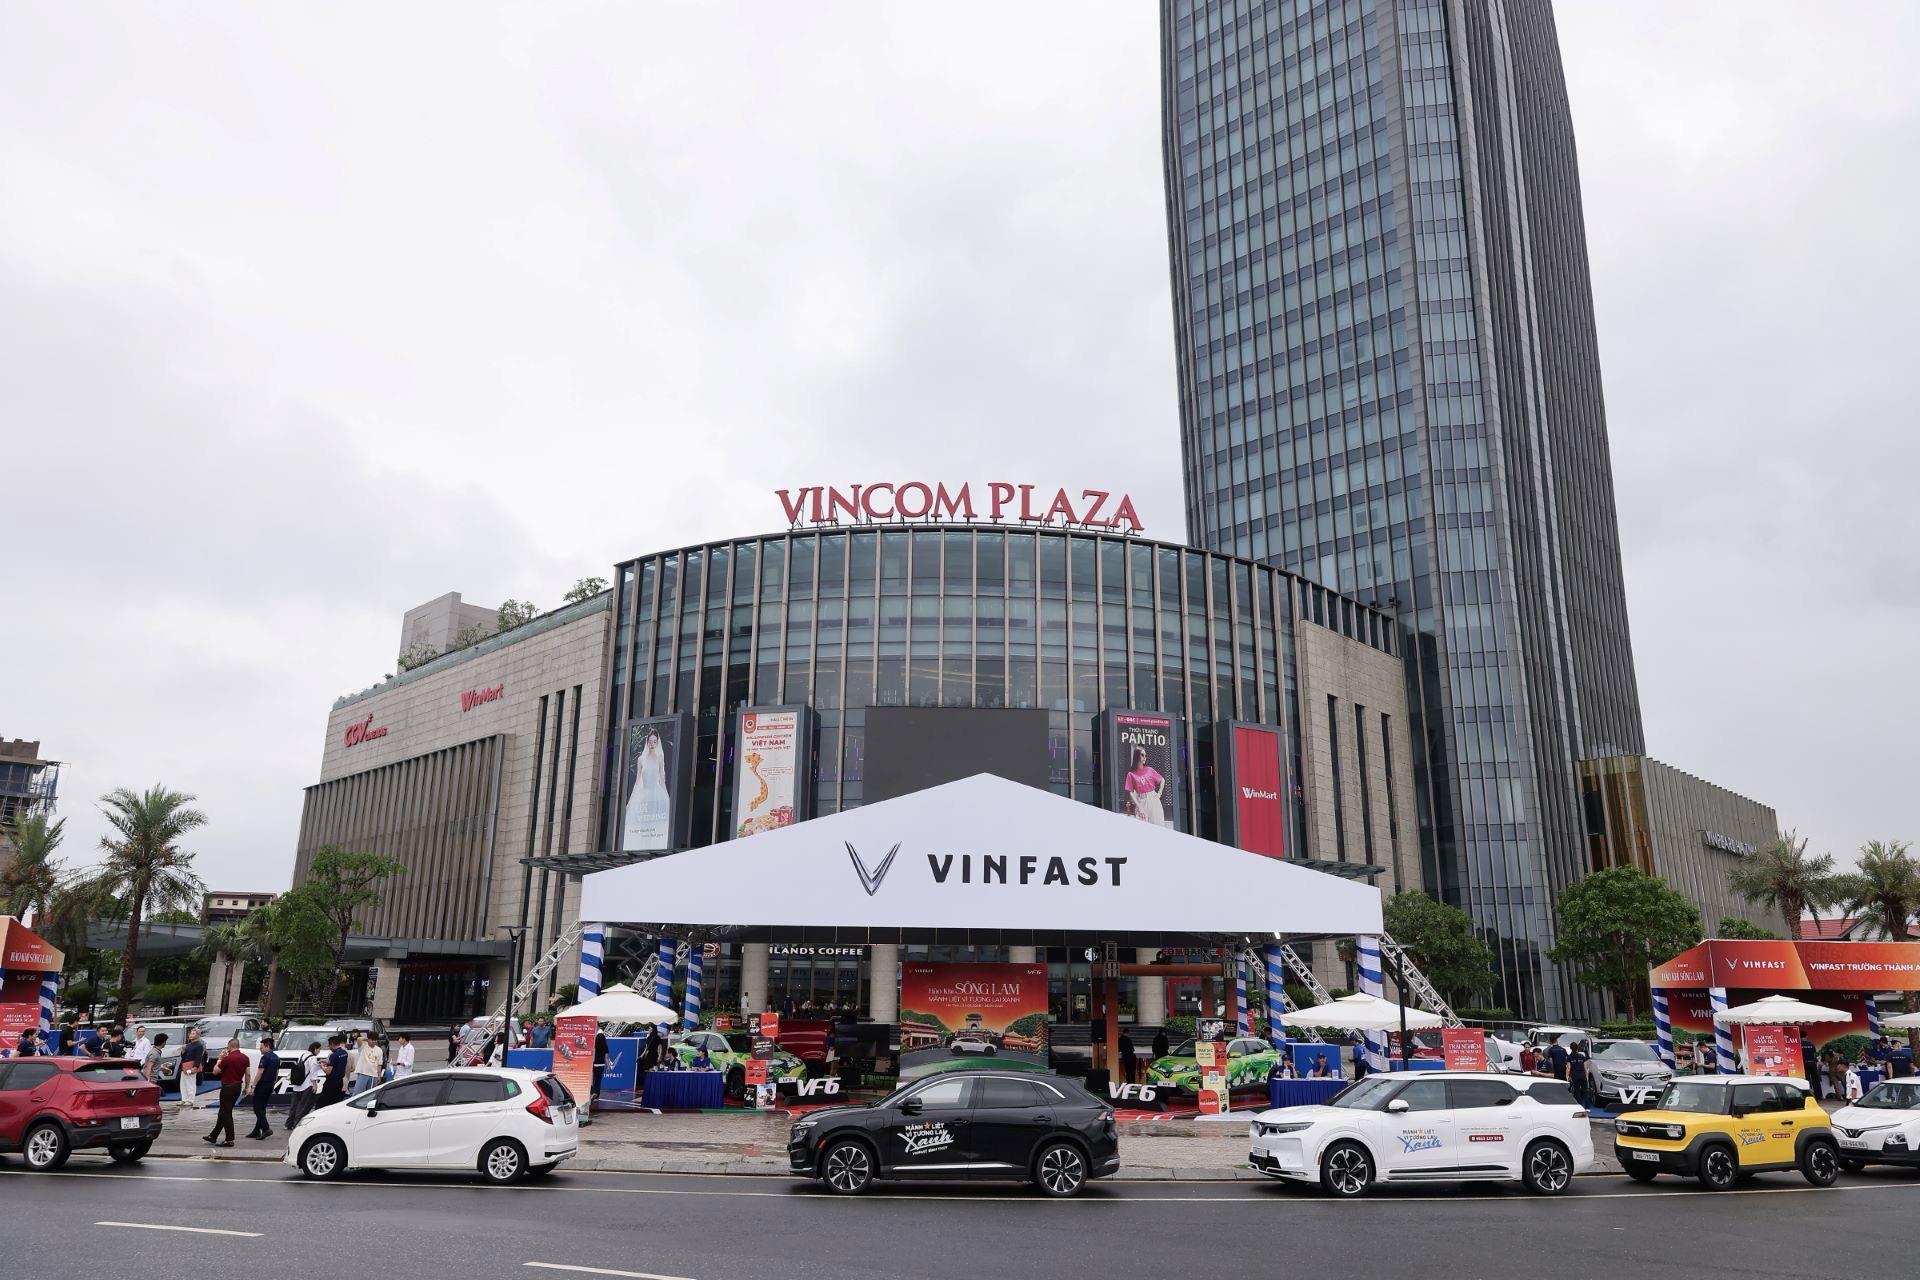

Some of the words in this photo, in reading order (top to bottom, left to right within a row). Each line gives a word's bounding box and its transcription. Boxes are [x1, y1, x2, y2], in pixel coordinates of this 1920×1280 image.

[775, 481, 977, 525] VINCOM
[987, 483, 1145, 531] PLAZA
[461, 684, 504, 712] WinMart
[1121, 732, 1166, 746] PANTIO
[1242, 787, 1277, 800] WinMart
[927, 854, 1128, 886] VINFAST
[818, 947, 863, 957] COFFEE
[1743, 961, 1785, 969] VINFAST
[1810, 963, 1845, 971] VINFAST
[1846, 962, 1882, 971] TRƯỜNG
[1884, 962, 1913, 971] THÀNH
[955, 981, 989, 996] SÔNG
[992, 983, 1020, 996] LAM
[797, 1077, 842, 1097] VF6
[1109, 1082, 1157, 1102] VF6
[897, 1131, 955, 1153] Xanh
